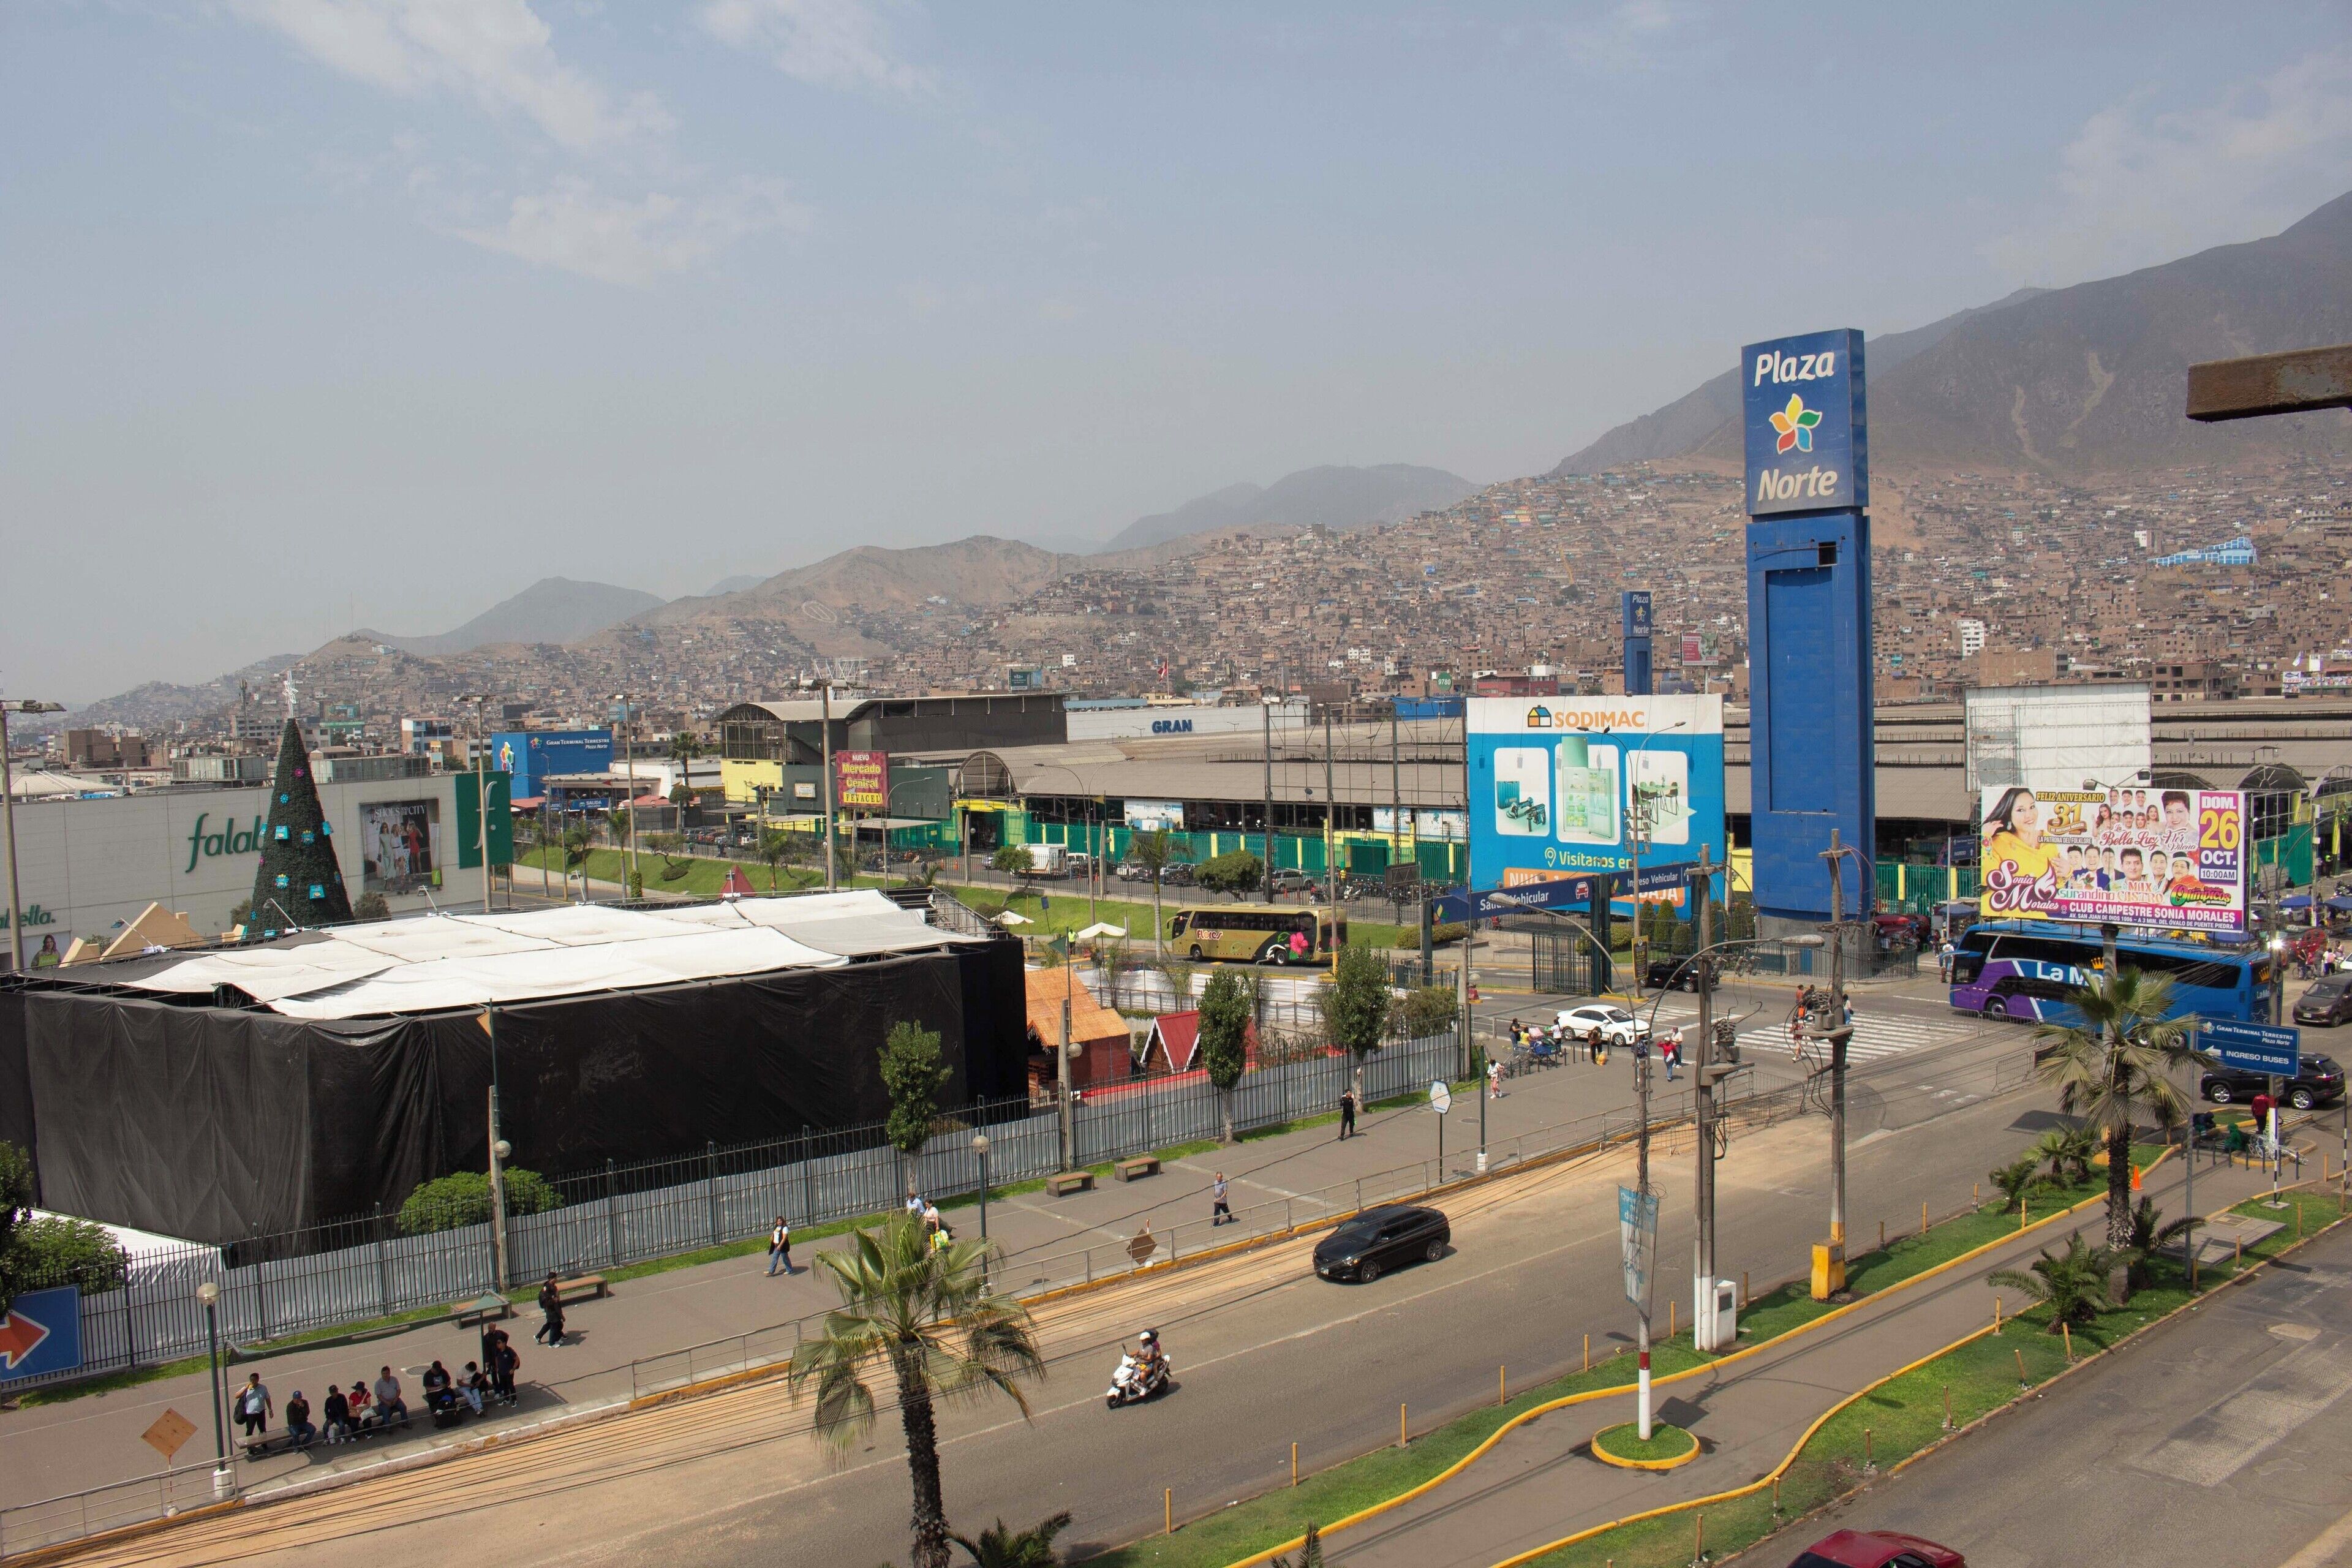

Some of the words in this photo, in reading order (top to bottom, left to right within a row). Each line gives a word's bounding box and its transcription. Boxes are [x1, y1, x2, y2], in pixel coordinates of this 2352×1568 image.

[1754, 350, 1835, 387] Plaza
[1758, 466, 1838, 502] Norte
[1632, 594, 1648, 603] Plaza
[1634, 625, 1649, 634] Norte
[1152, 719, 1192, 733] GRAN
[1555, 711, 1645, 728] SODIMAC
[842, 762, 881, 774] Mercado
[846, 777, 879, 789] Central
[846, 793, 881, 802] FEVACEL
[2036, 792, 2056, 802] FELIZ
[2057, 792, 2105, 802] ANIVERSARIO
[2201, 796, 2236, 809] DOM.
[409, 805, 426, 815] CITY
[2054, 803, 2082, 834] 31
[2163, 828, 2186, 844] Flor
[2199, 810, 2239, 850] 26
[2099, 831, 2133, 846] Bella
[2134, 831, 2160, 851] Luz
[1559, 851, 1615, 868] Visítanos
[2201, 850, 2237, 865] OCT.
[1651, 872, 1678, 883] Vehicular
[1988, 859, 2034, 890] Sonia
[2202, 870, 2235, 879] 10:00AM
[2128, 881, 2152, 892] MAX
[1991, 884, 2059, 910] Morales
[2060, 888, 2115, 900] surandino
[2117, 891, 2164, 903] CASTRO
[2070, 902, 2094, 913] CLUB
[2095, 903, 2152, 917] CAMPESTRE
[2154, 907, 2185, 920] SONIA
[2187, 910, 2236, 922] MORALES
[2037, 962, 2064, 982] La
[2233, 1027, 2261, 1036] TERMINAL
[2261, 1030, 2294, 1040] TERRESTRE
[2226, 1050, 2261, 1060] INGRESO
[2263, 1055, 2290, 1065] BUSES
